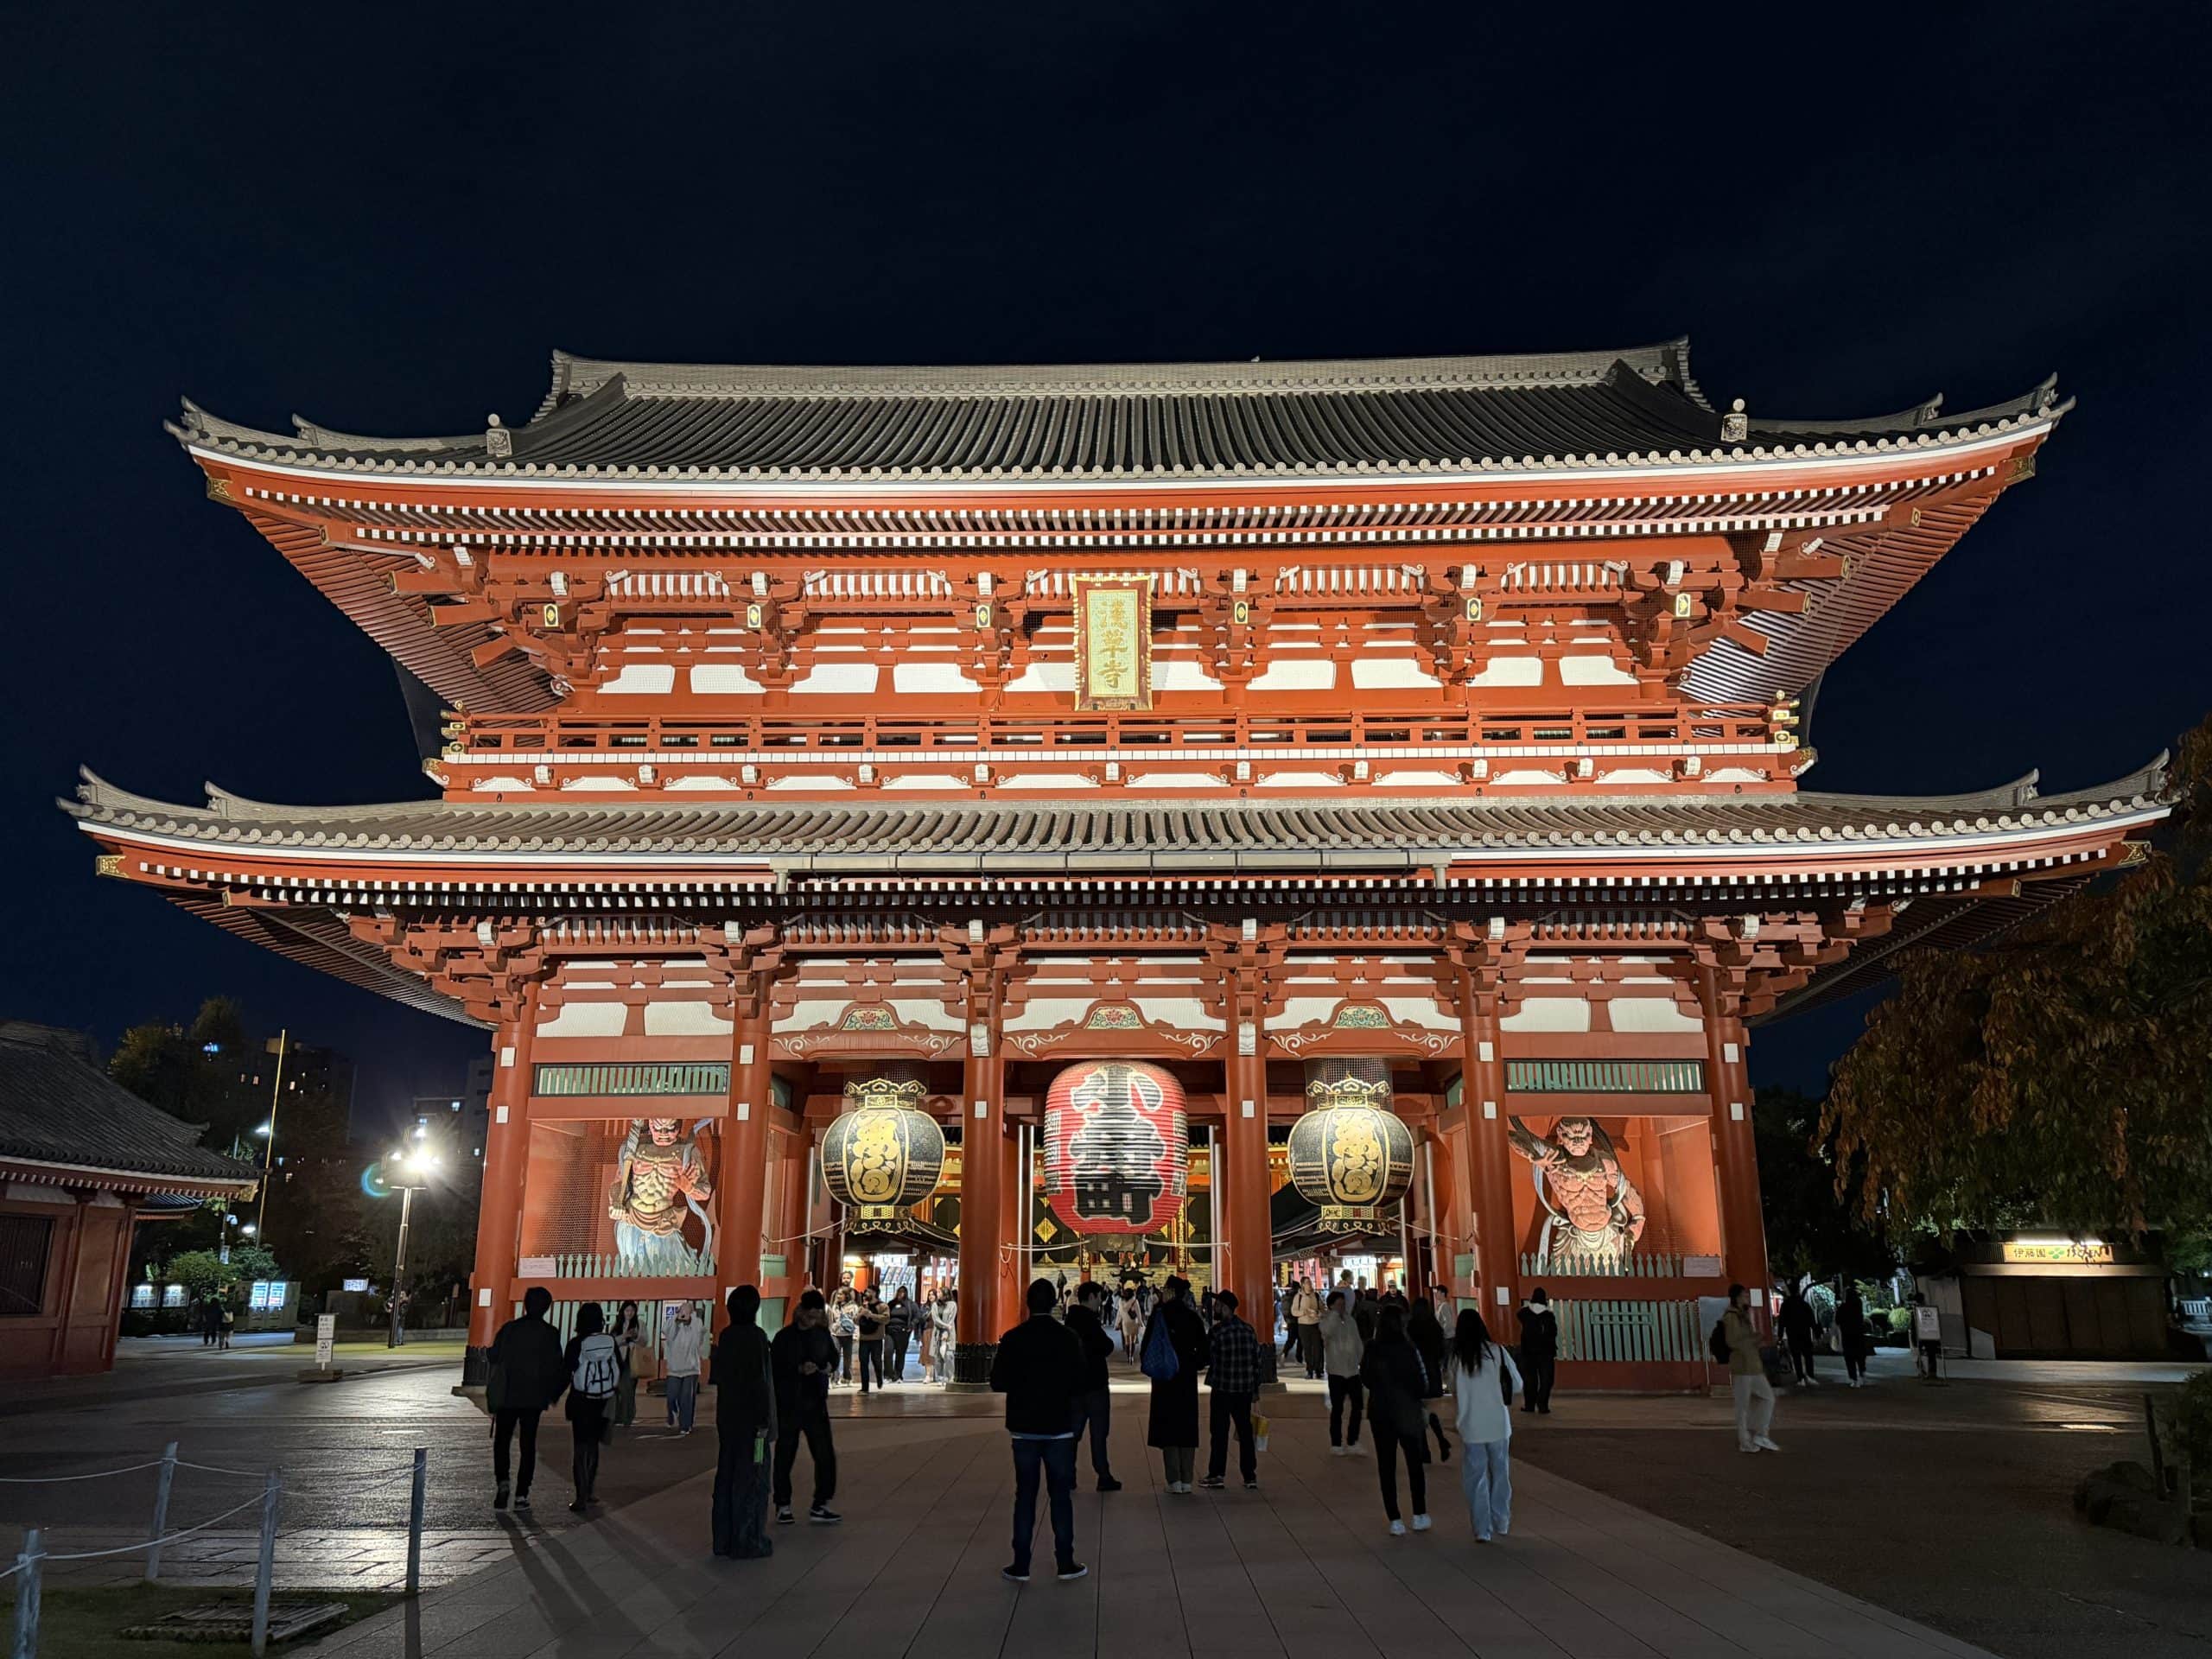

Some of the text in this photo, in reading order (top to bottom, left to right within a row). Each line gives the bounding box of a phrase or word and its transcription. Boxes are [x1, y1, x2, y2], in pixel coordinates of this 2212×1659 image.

[1069, 1065, 1166, 1227] 小舟町
[2014, 1248, 2046, 1258] 伊藤園
